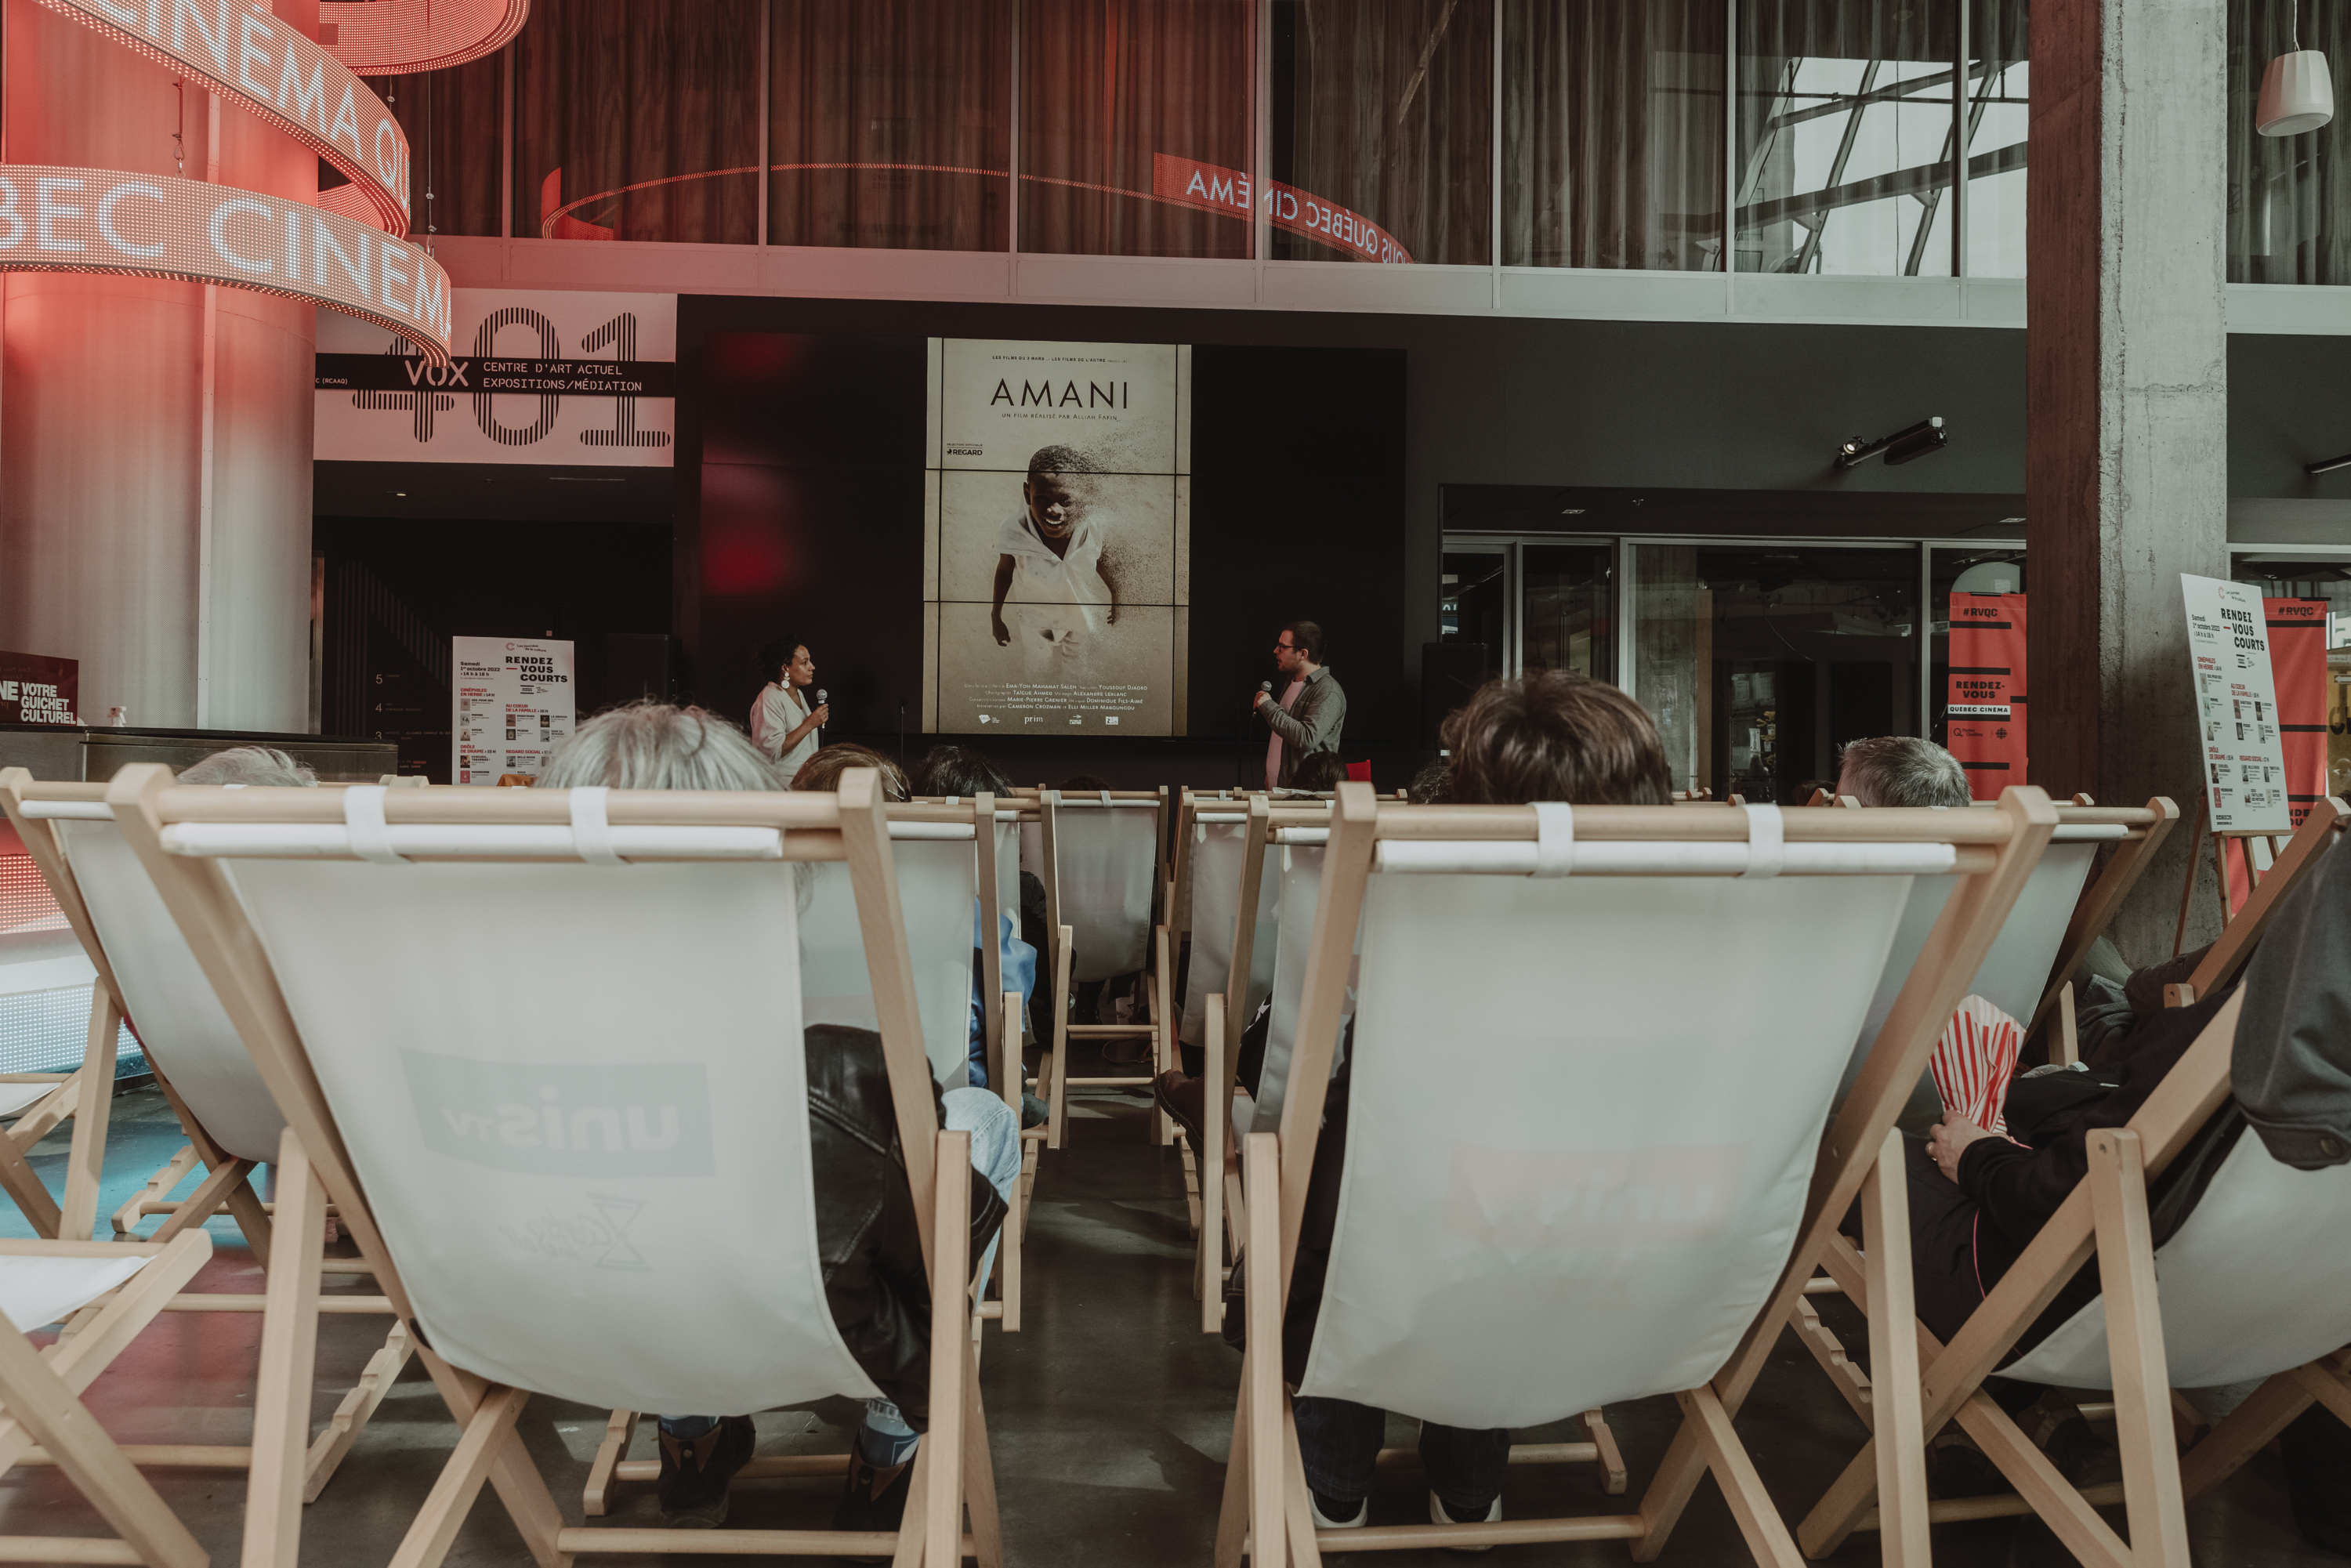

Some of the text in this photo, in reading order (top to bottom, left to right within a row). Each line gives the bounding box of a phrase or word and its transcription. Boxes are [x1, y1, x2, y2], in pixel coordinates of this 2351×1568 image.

[405, 359, 469, 387] VOX
[483, 362, 622, 375] CENTRE D'ART ACTUEL
[990, 378, 1127, 409] AMANI
[1963, 608, 1998, 617] #RVQC
[2220, 607, 2253, 623] RENDEZ
[2278, 607, 2314, 617] #RVQC
[2232, 623, 2254, 636] VOUS
[2234, 636, 2265, 651] COURTS
[505, 656, 553, 665] RENDEZ
[375, 674, 383, 684] 5
[520, 674, 567, 683] COURTS
[21, 682, 57, 697] VOTRE
[1955, 681, 2005, 690] RENDEZ-
[1962, 690, 1995, 699] VOUS
[21, 696, 69, 711] GUICHET
[375, 702, 382, 712] 4
[20, 708, 76, 725] CULTUREL
[1024, 715, 1043, 724] prim
[375, 731, 382, 740] 3
